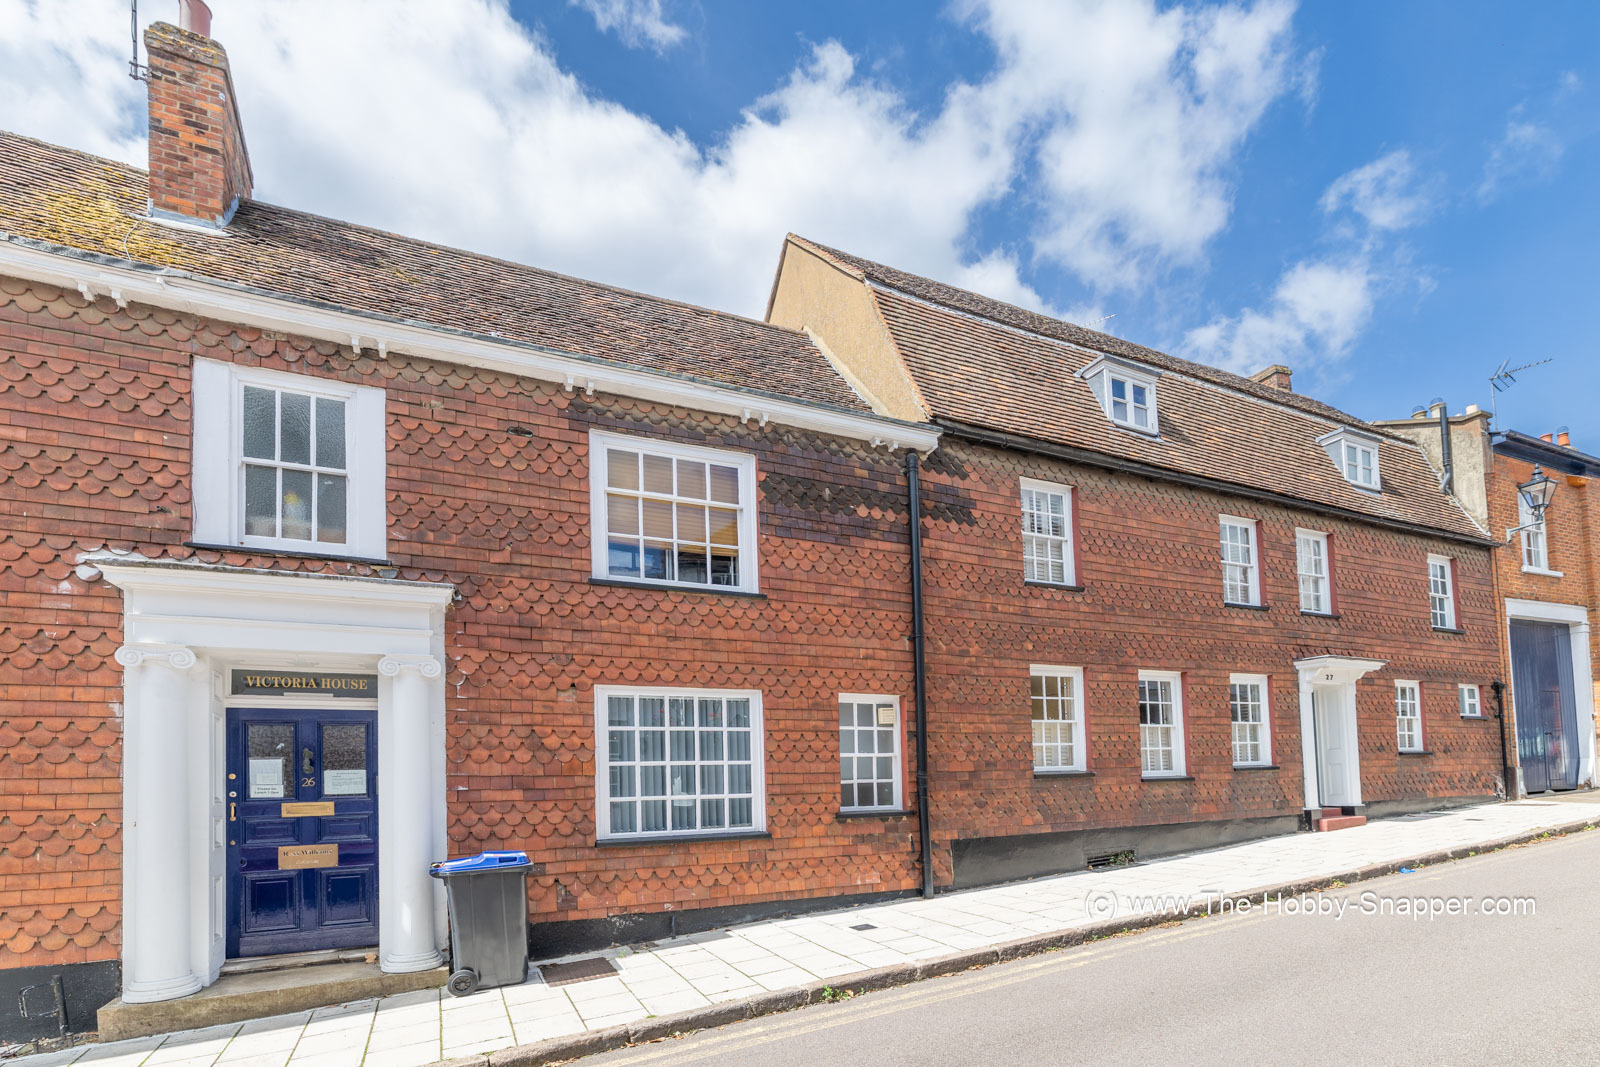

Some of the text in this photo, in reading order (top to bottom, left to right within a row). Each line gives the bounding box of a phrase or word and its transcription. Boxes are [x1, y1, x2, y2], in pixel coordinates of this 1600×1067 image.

[246, 676, 368, 690] VICTORIA HOUSE
[301, 777, 316, 787] 26
